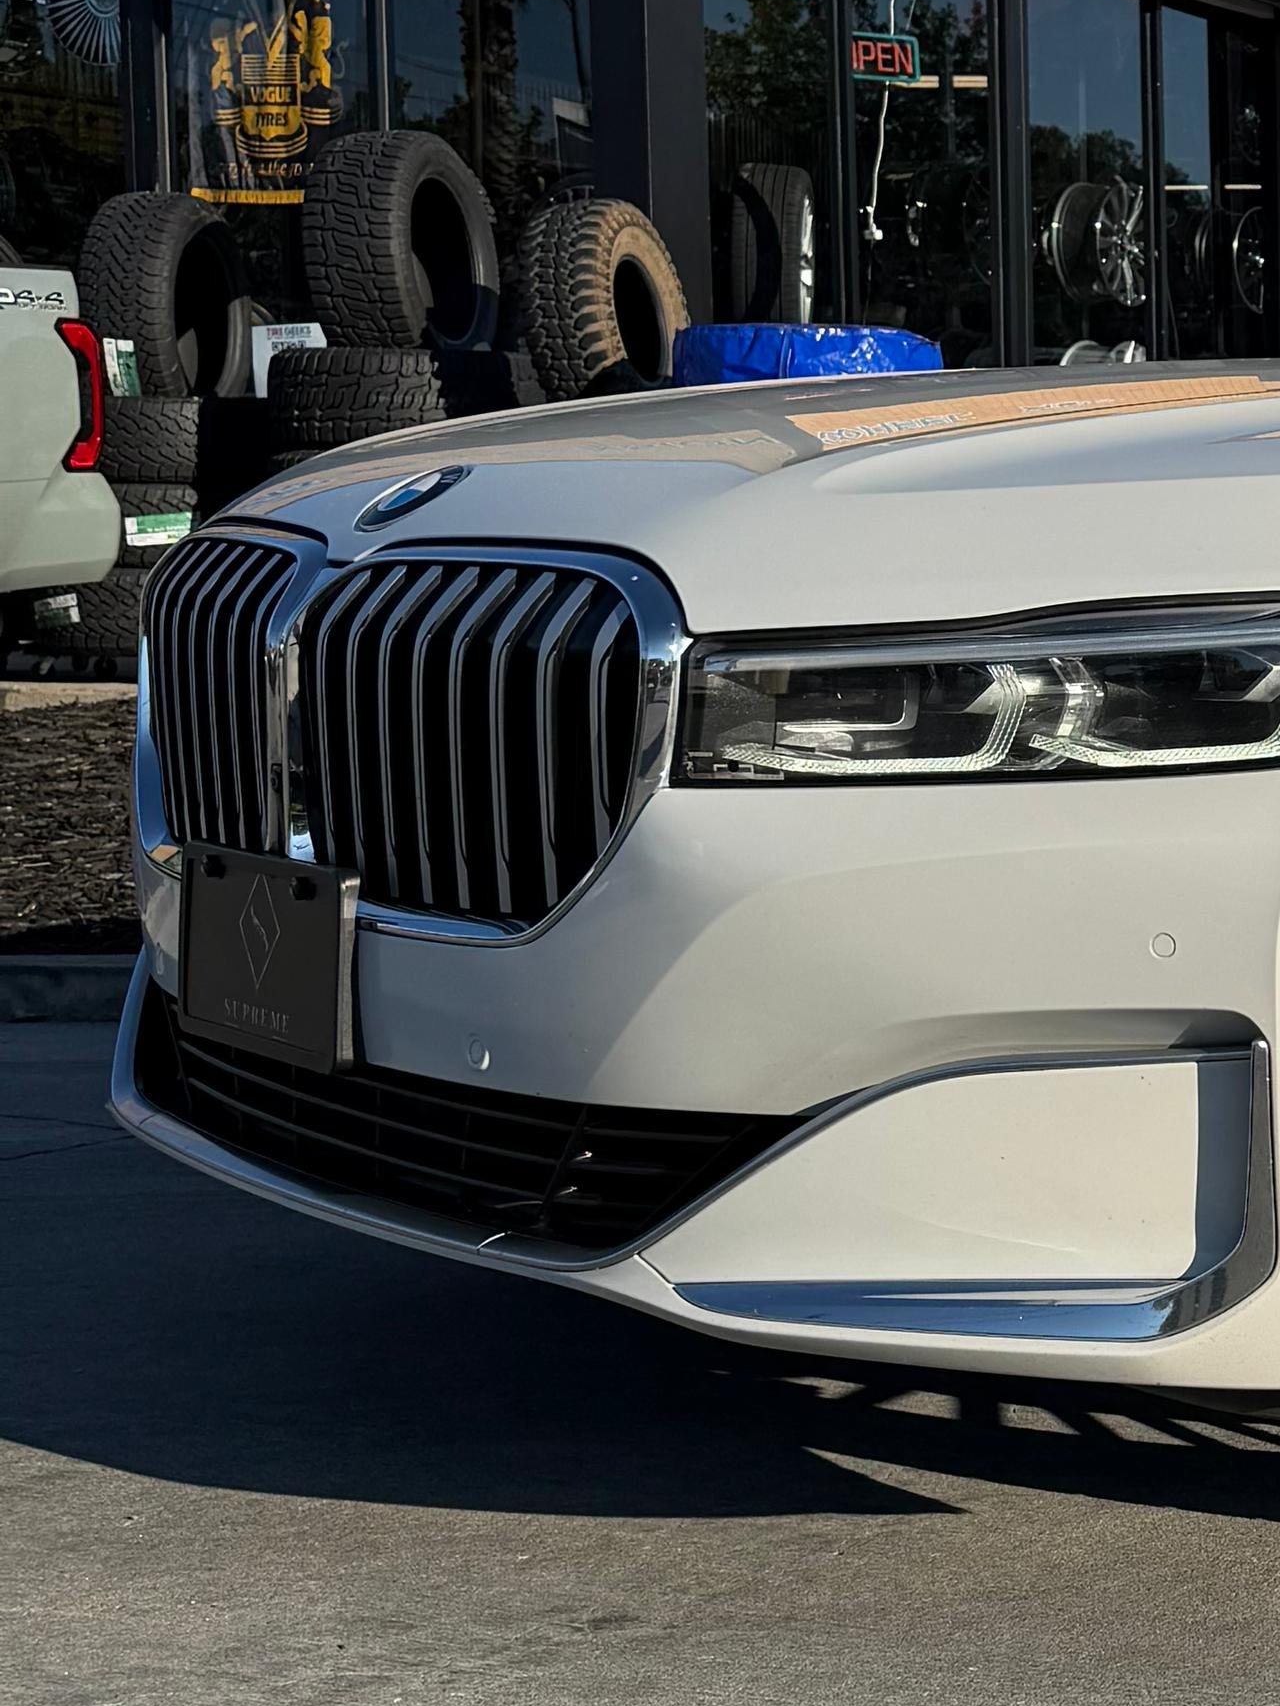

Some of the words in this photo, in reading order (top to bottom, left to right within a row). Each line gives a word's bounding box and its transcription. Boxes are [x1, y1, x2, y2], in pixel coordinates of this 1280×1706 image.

[248, 85, 293, 105] VOGUE
[255, 111, 289, 127] TYRES
[224, 997, 290, 1035] SUPREME
